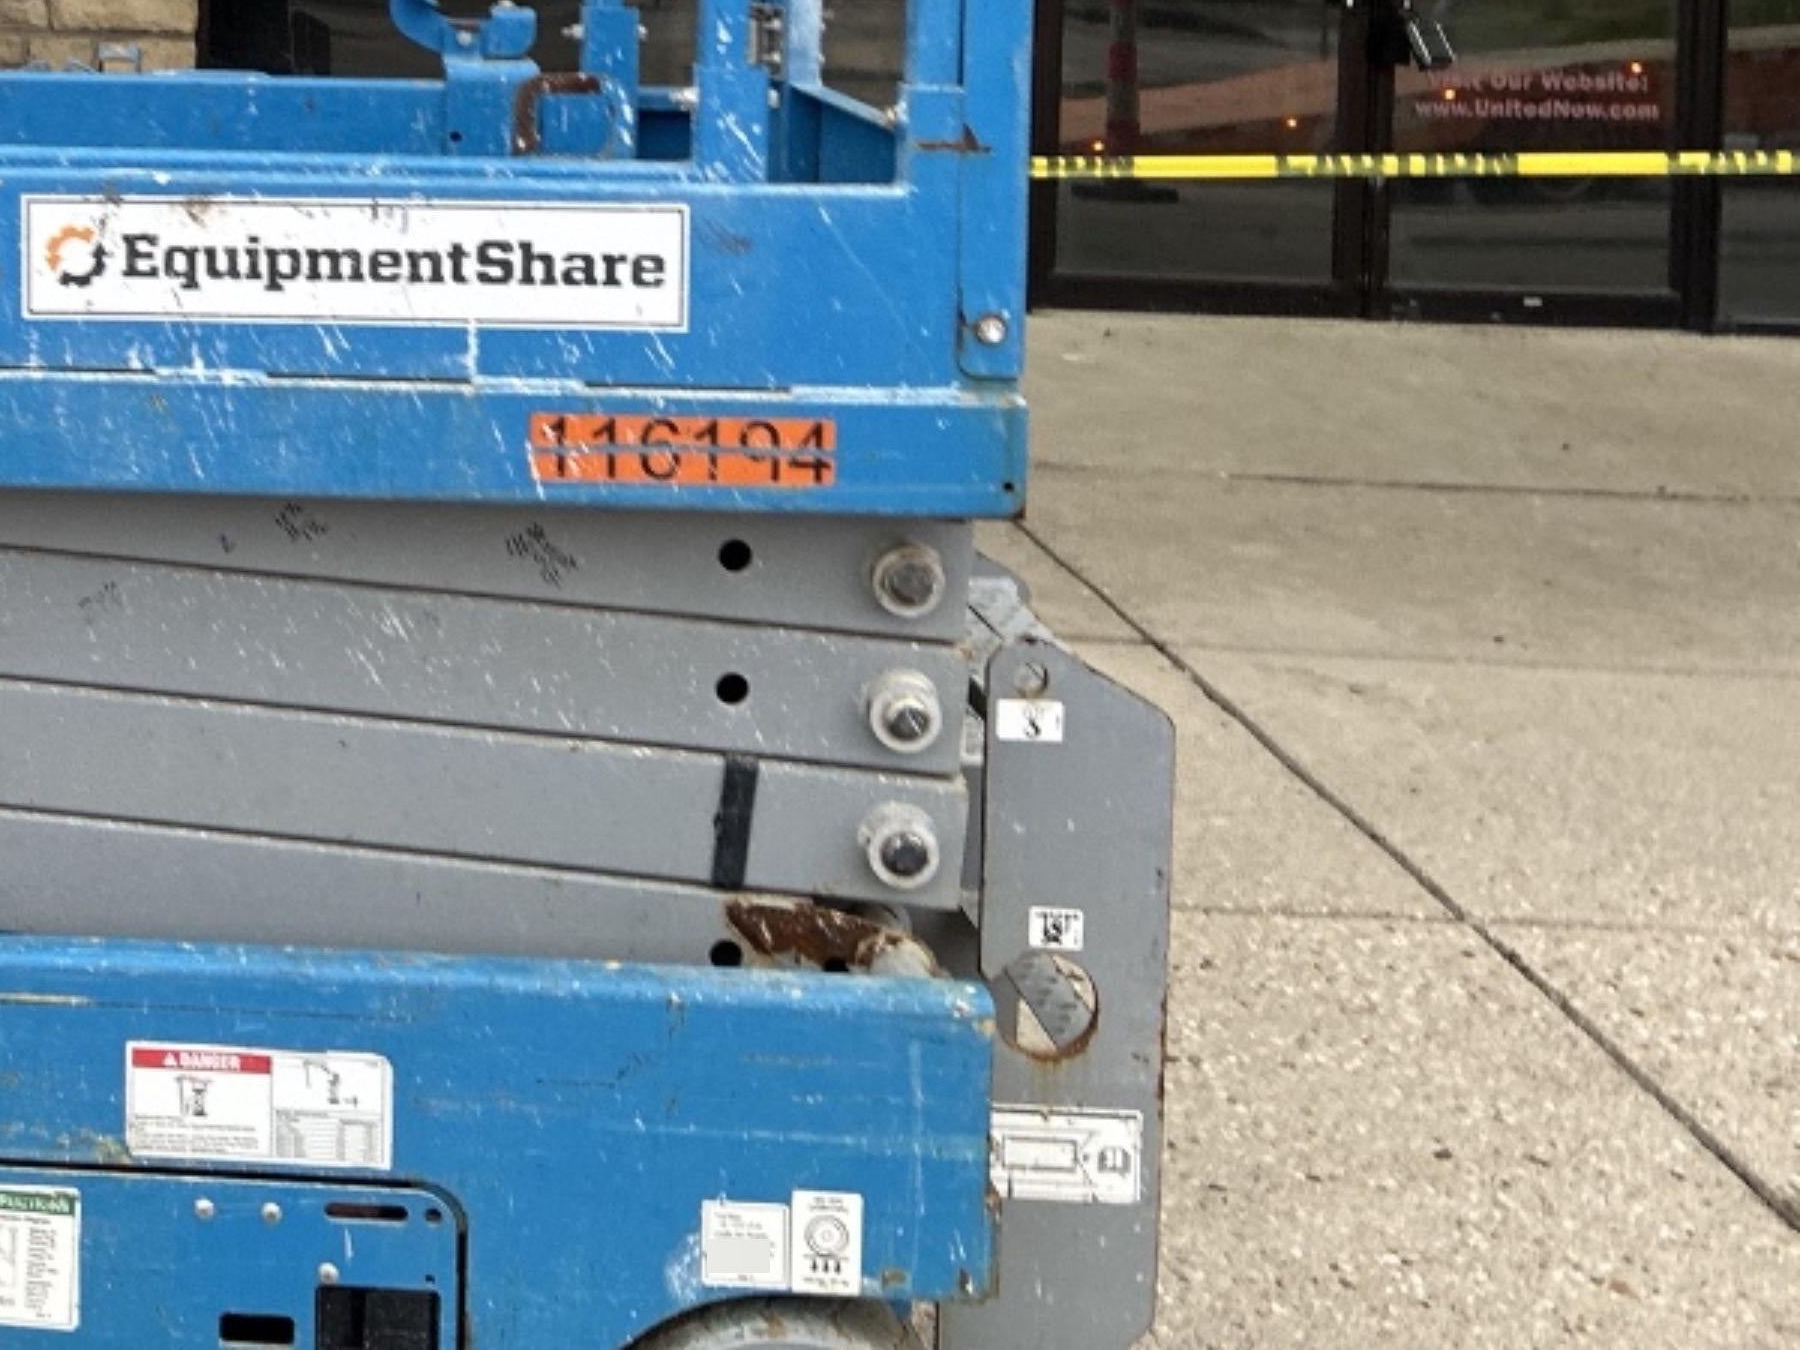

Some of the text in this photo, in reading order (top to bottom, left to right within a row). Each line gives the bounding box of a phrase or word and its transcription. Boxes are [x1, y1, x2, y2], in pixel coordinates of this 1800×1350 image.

[1491, 73, 1534, 92] Our
[1541, 69, 1650, 94] Website:
[1415, 98, 1659, 121] www.UnitedNow.com
[121, 233, 666, 291] EquipmentShare
[542, 416, 833, 484] 116194
[180, 1051, 241, 1070] DANGER
